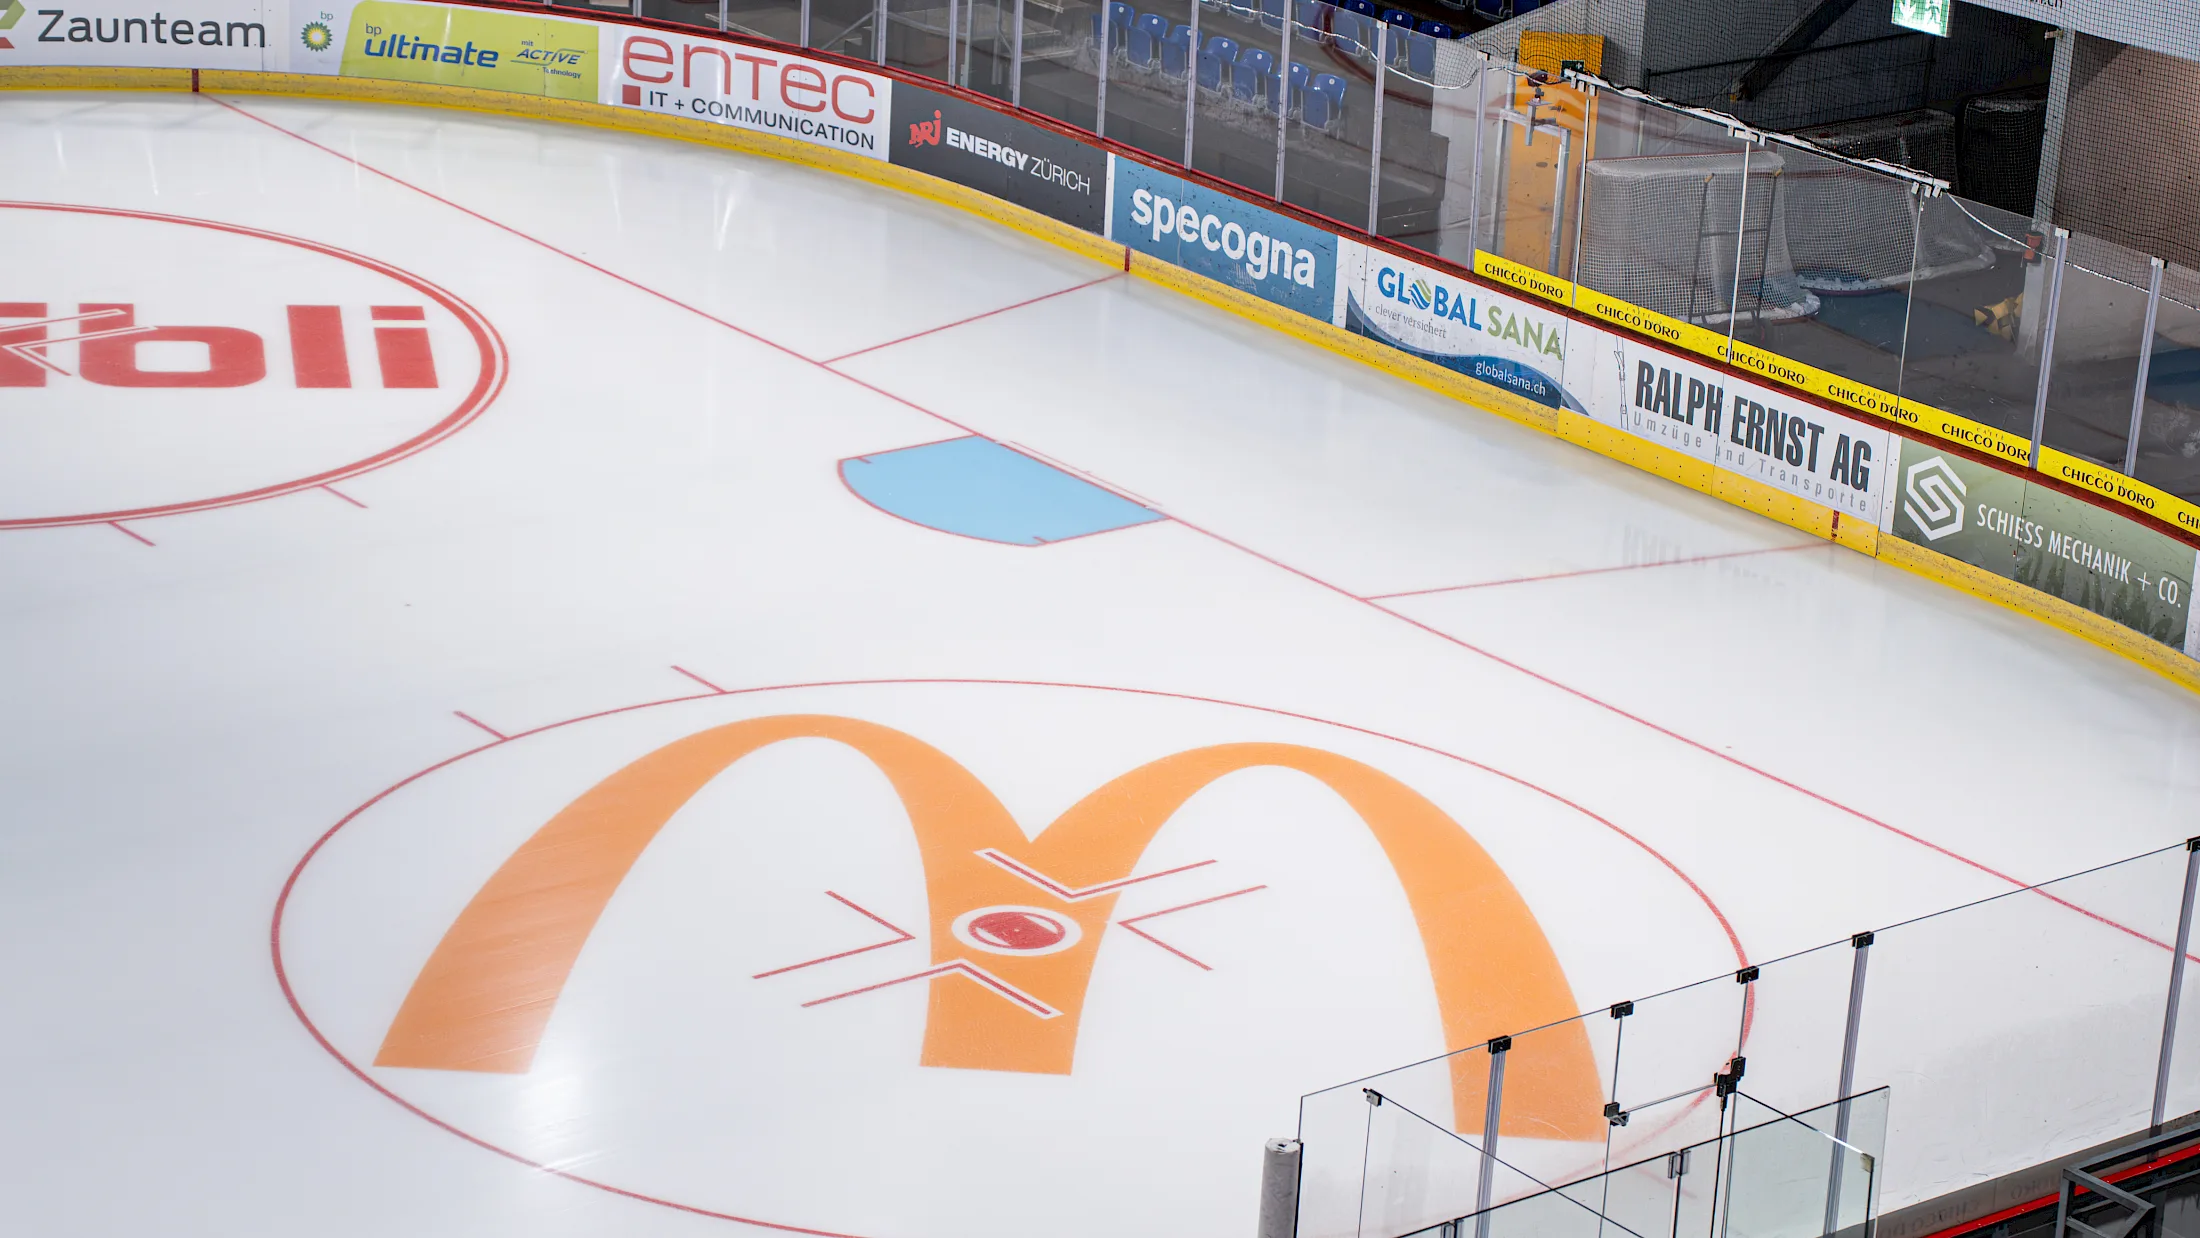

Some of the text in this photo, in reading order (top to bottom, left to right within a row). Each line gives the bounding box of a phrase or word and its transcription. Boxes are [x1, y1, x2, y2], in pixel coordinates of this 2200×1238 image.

[38, 9, 265, 48] Zaunteam
[320, 11, 333, 22] bp
[365, 23, 382, 36] bp
[364, 34, 499, 68] ultimate
[516, 48, 581, 65] ACTIVE
[649, 90, 874, 150] IT + COMMUNICATION
[946, 126, 1029, 171] ENERGY
[1030, 157, 1091, 195] ZÜRICH
[1130, 188, 1316, 289] specogna
[1484, 263, 1527, 286] CHICCO
[1529, 278, 1564, 300] D'ORO
[1375, 304, 1447, 339] clever versichert
[1377, 267, 1563, 361] GLOBAL SANA
[1596, 303, 1641, 327] CHICCO
[1644, 319, 1680, 341] D'ORO
[1475, 360, 1546, 397] globalsana.ch
[1717, 345, 1805, 385] CHICCO D'ORO
[1828, 384, 1919, 424] CHICCO D'ORO
[1635, 359, 1872, 493] RALPH ERNST AG
[1941, 422, 1993, 449] CHICCO
[1633, 410, 1702, 448] Umzüge
[1759, 458, 1867, 512] Transporte
[2062, 465, 2156, 510] CHICCO D'ORO
[2178, 511, 2200, 529] CHI
[1976, 503, 2045, 549] SCHIESS
[2047, 530, 2133, 584] MECHANIK
[2136, 571, 2151, 591] +
[2158, 576, 2181, 608] CO.
